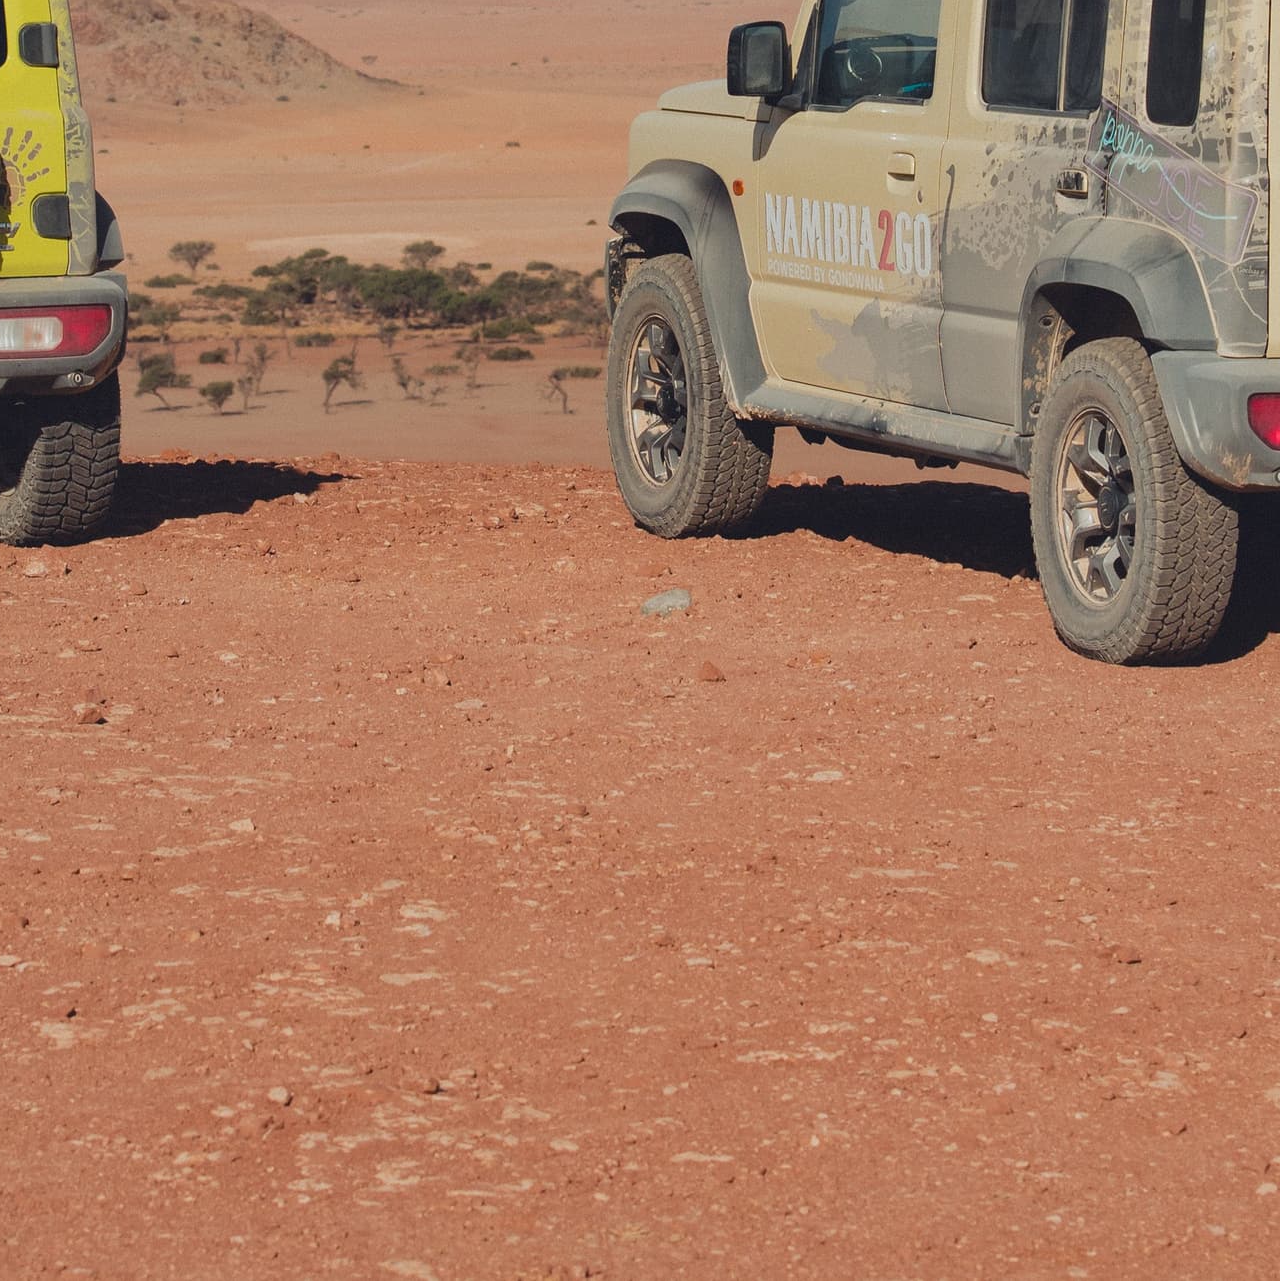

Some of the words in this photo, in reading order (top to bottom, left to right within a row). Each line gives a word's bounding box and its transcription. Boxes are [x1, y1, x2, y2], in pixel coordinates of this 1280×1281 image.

[766, 192, 932, 277] NAMIBIA2GO
[768, 259, 812, 282] POWERED
[814, 266, 827, 285] BY
[829, 269, 885, 293] GONDWANA
